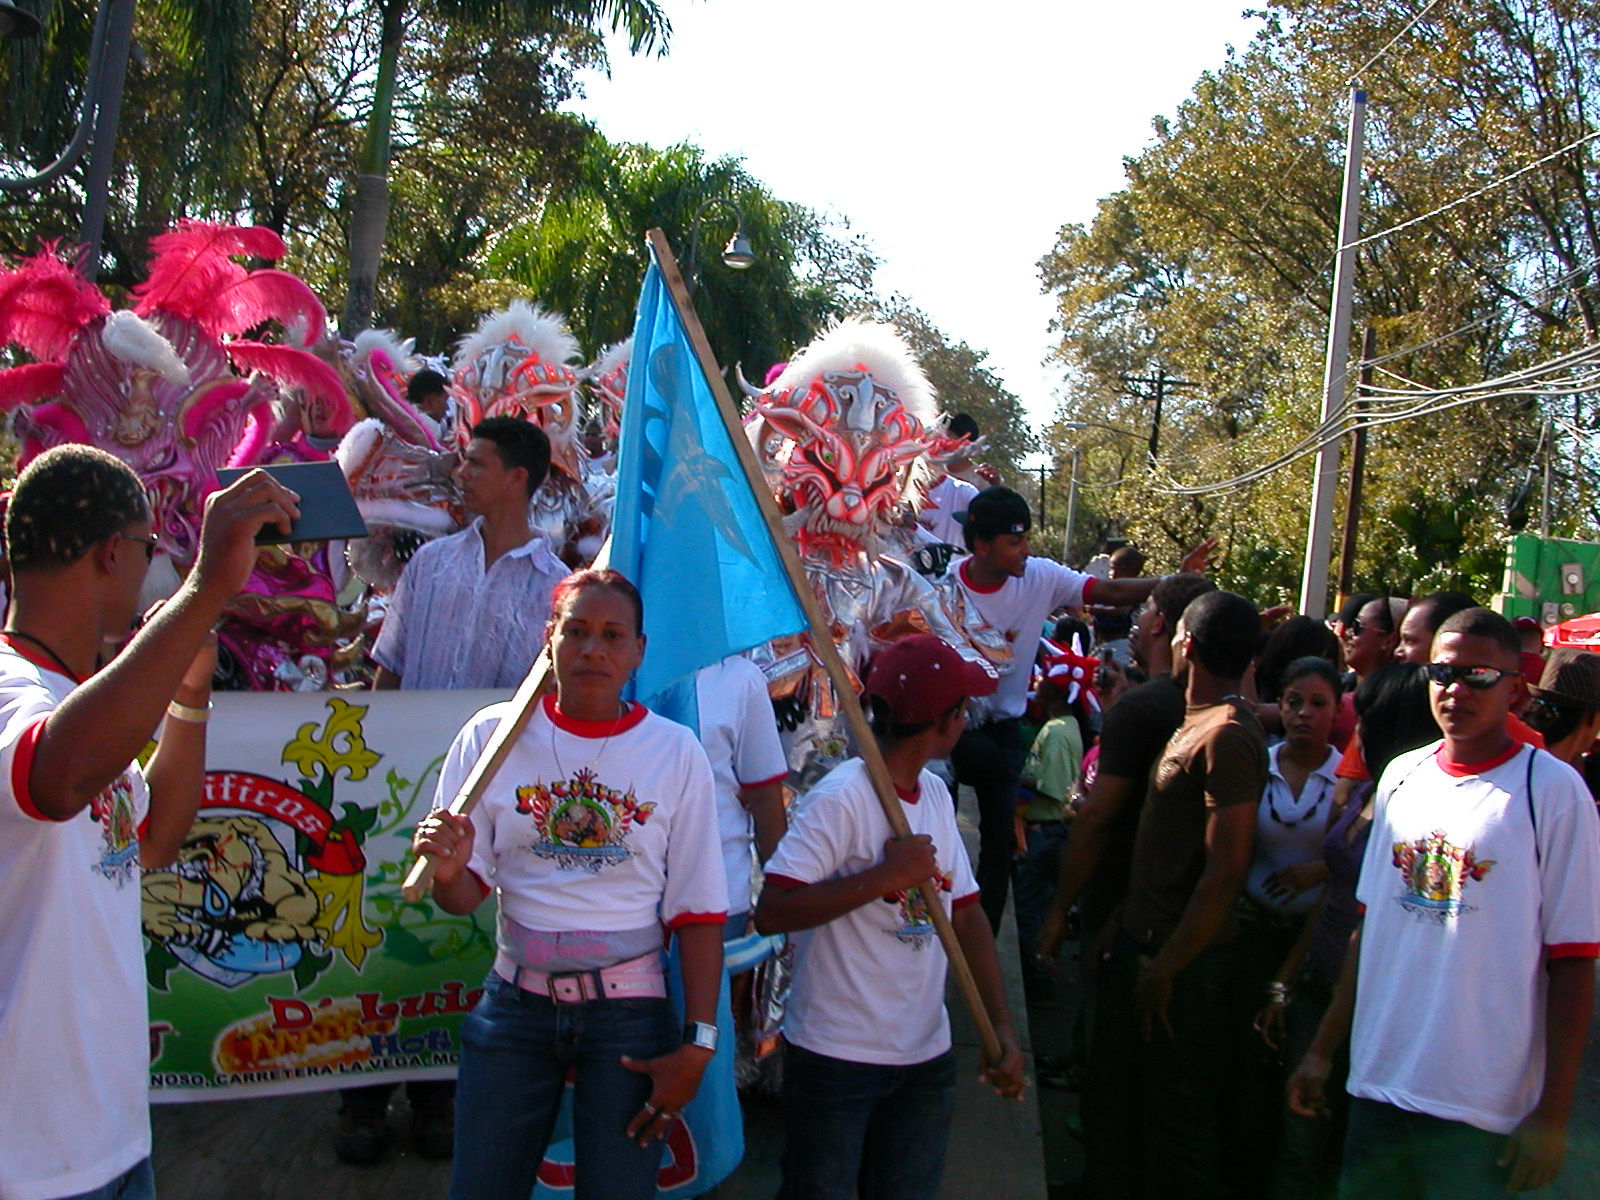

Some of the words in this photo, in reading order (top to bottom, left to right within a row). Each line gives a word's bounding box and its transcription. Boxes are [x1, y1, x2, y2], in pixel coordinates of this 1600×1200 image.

[150, 1071, 211, 1088] NOSO,
[216, 1063, 333, 1086] CARRETERA
[338, 1060, 363, 1075] LA
